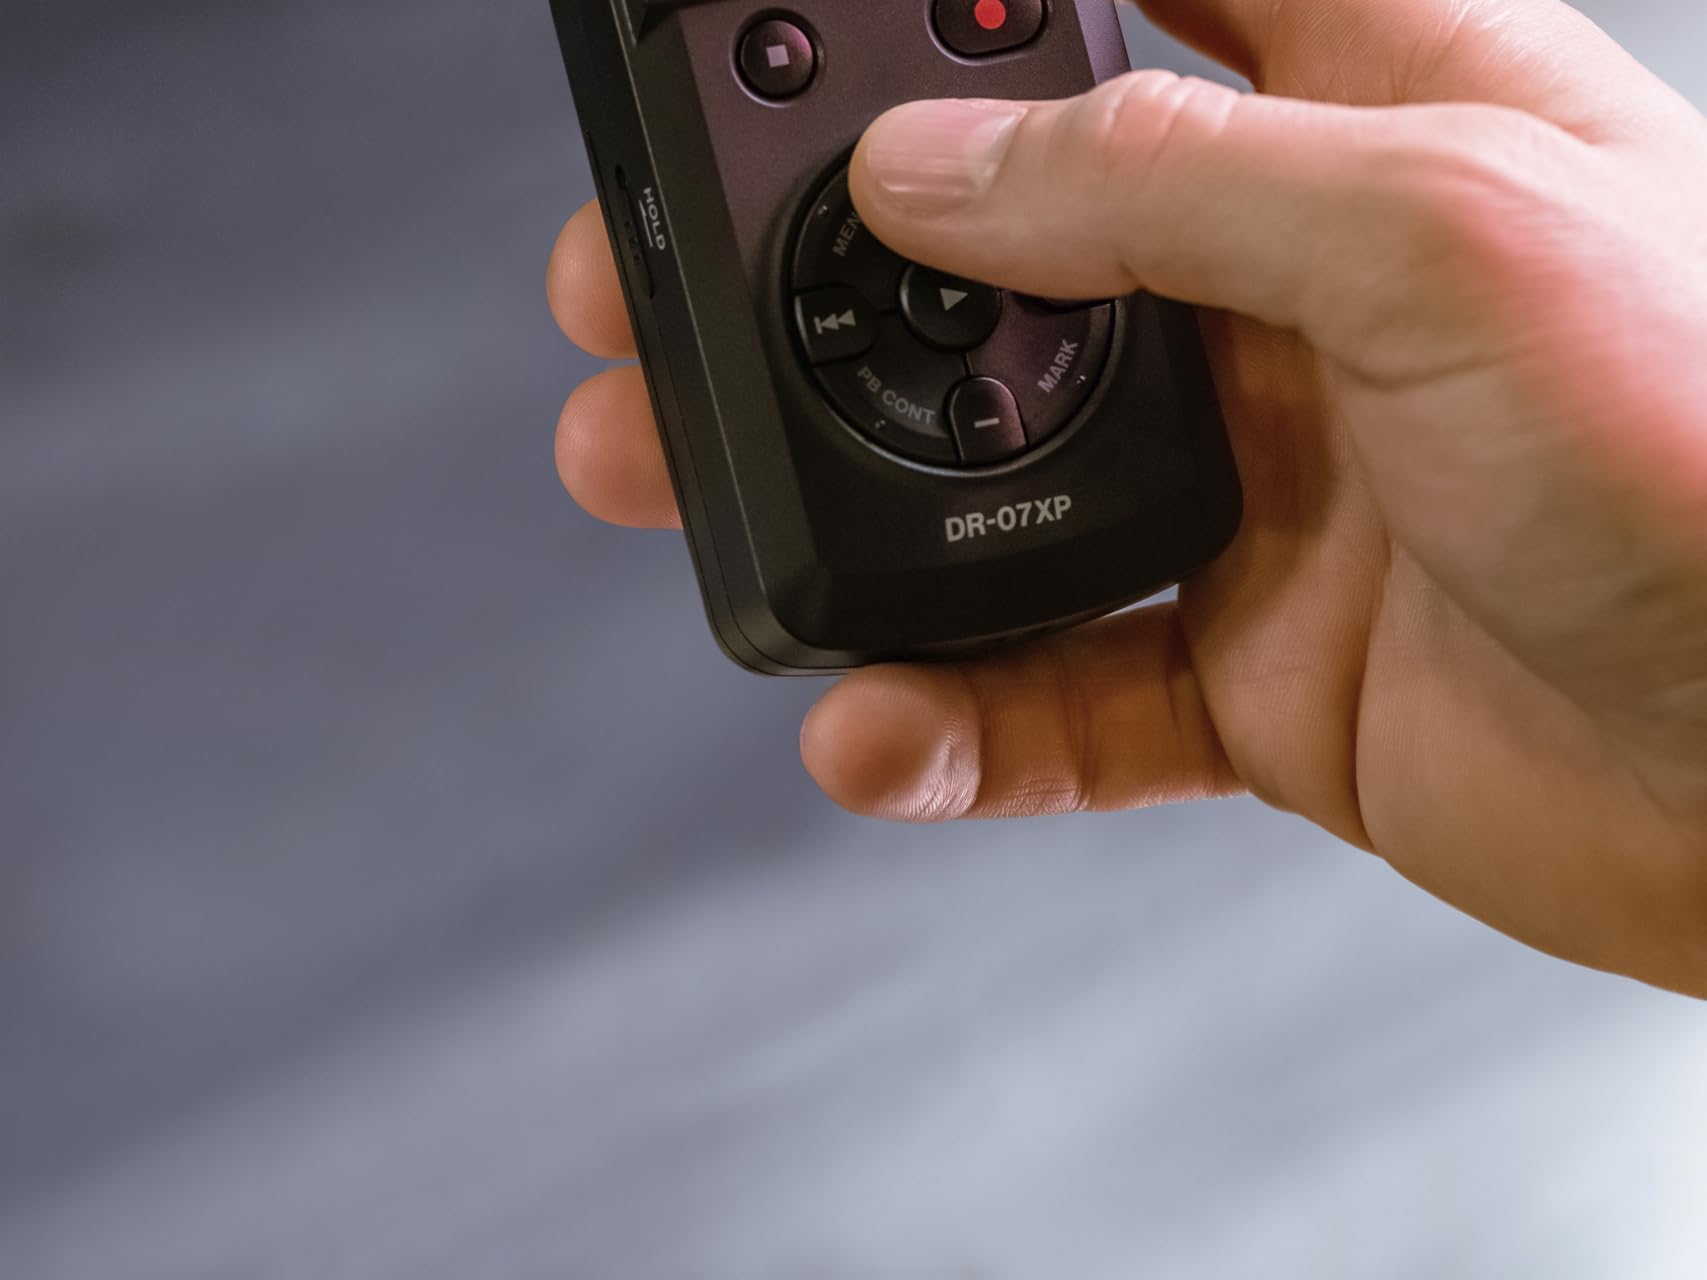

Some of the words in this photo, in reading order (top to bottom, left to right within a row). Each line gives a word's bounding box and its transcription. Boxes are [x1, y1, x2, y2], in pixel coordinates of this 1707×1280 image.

[643, 187, 666, 250] HOLD
[832, 211, 861, 256] MEN
[1037, 338, 1079, 393] MARK
[857, 366, 882, 393] PB
[882, 389, 936, 425] CONT
[945, 495, 1072, 542] DR-07XP
